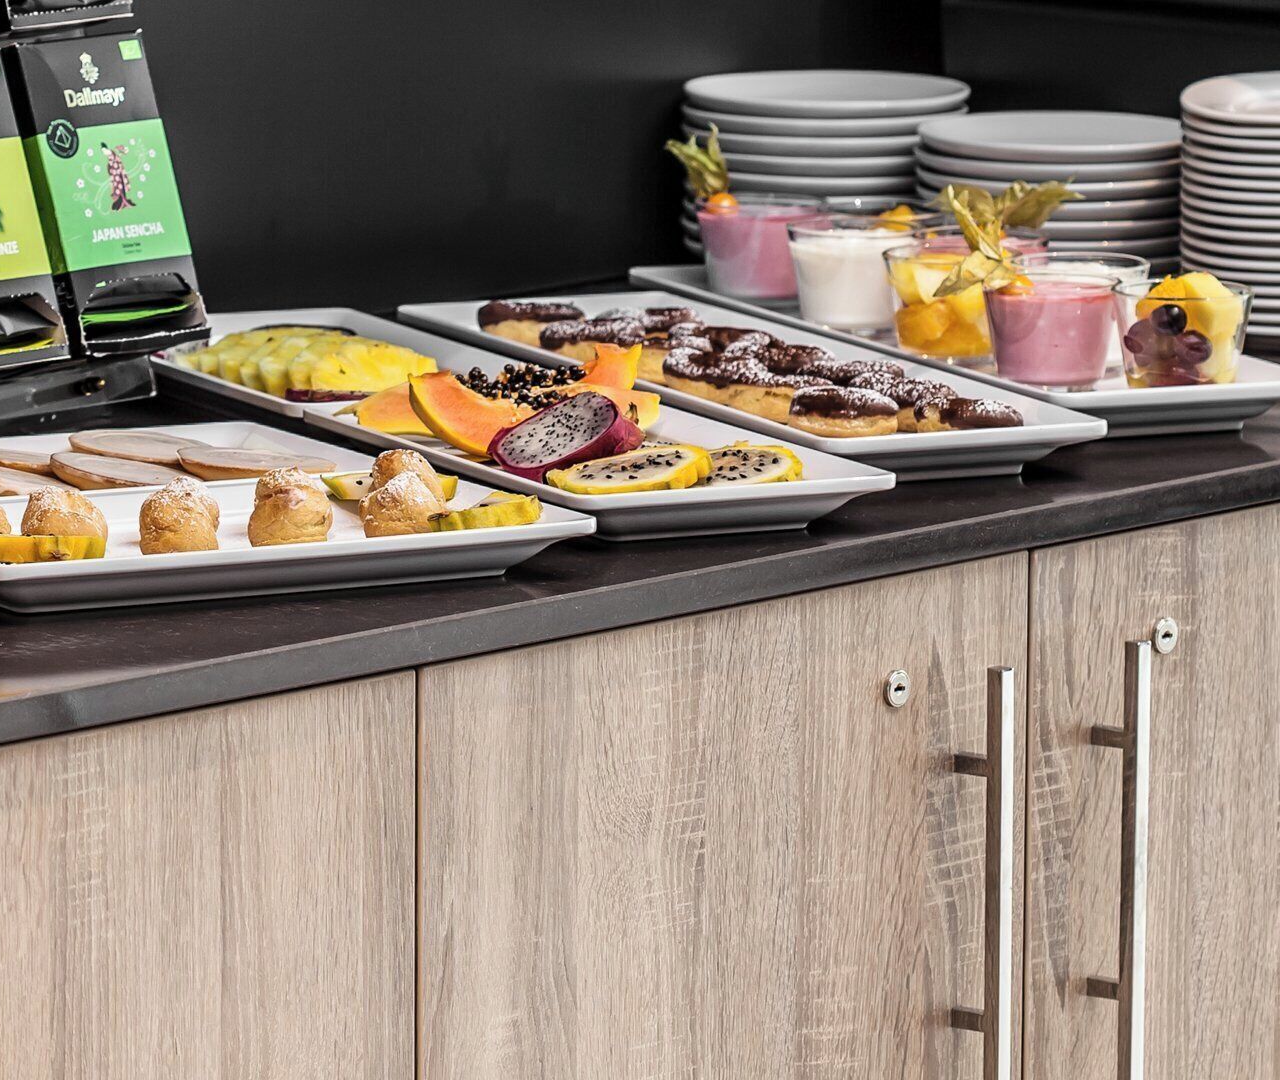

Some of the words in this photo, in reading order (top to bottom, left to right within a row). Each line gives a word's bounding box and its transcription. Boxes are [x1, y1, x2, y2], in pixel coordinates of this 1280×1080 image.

[63, 86, 126, 108] Dallmayr
[92, 226, 125, 244] JAPAN
[125, 221, 165, 239] SENCHA
